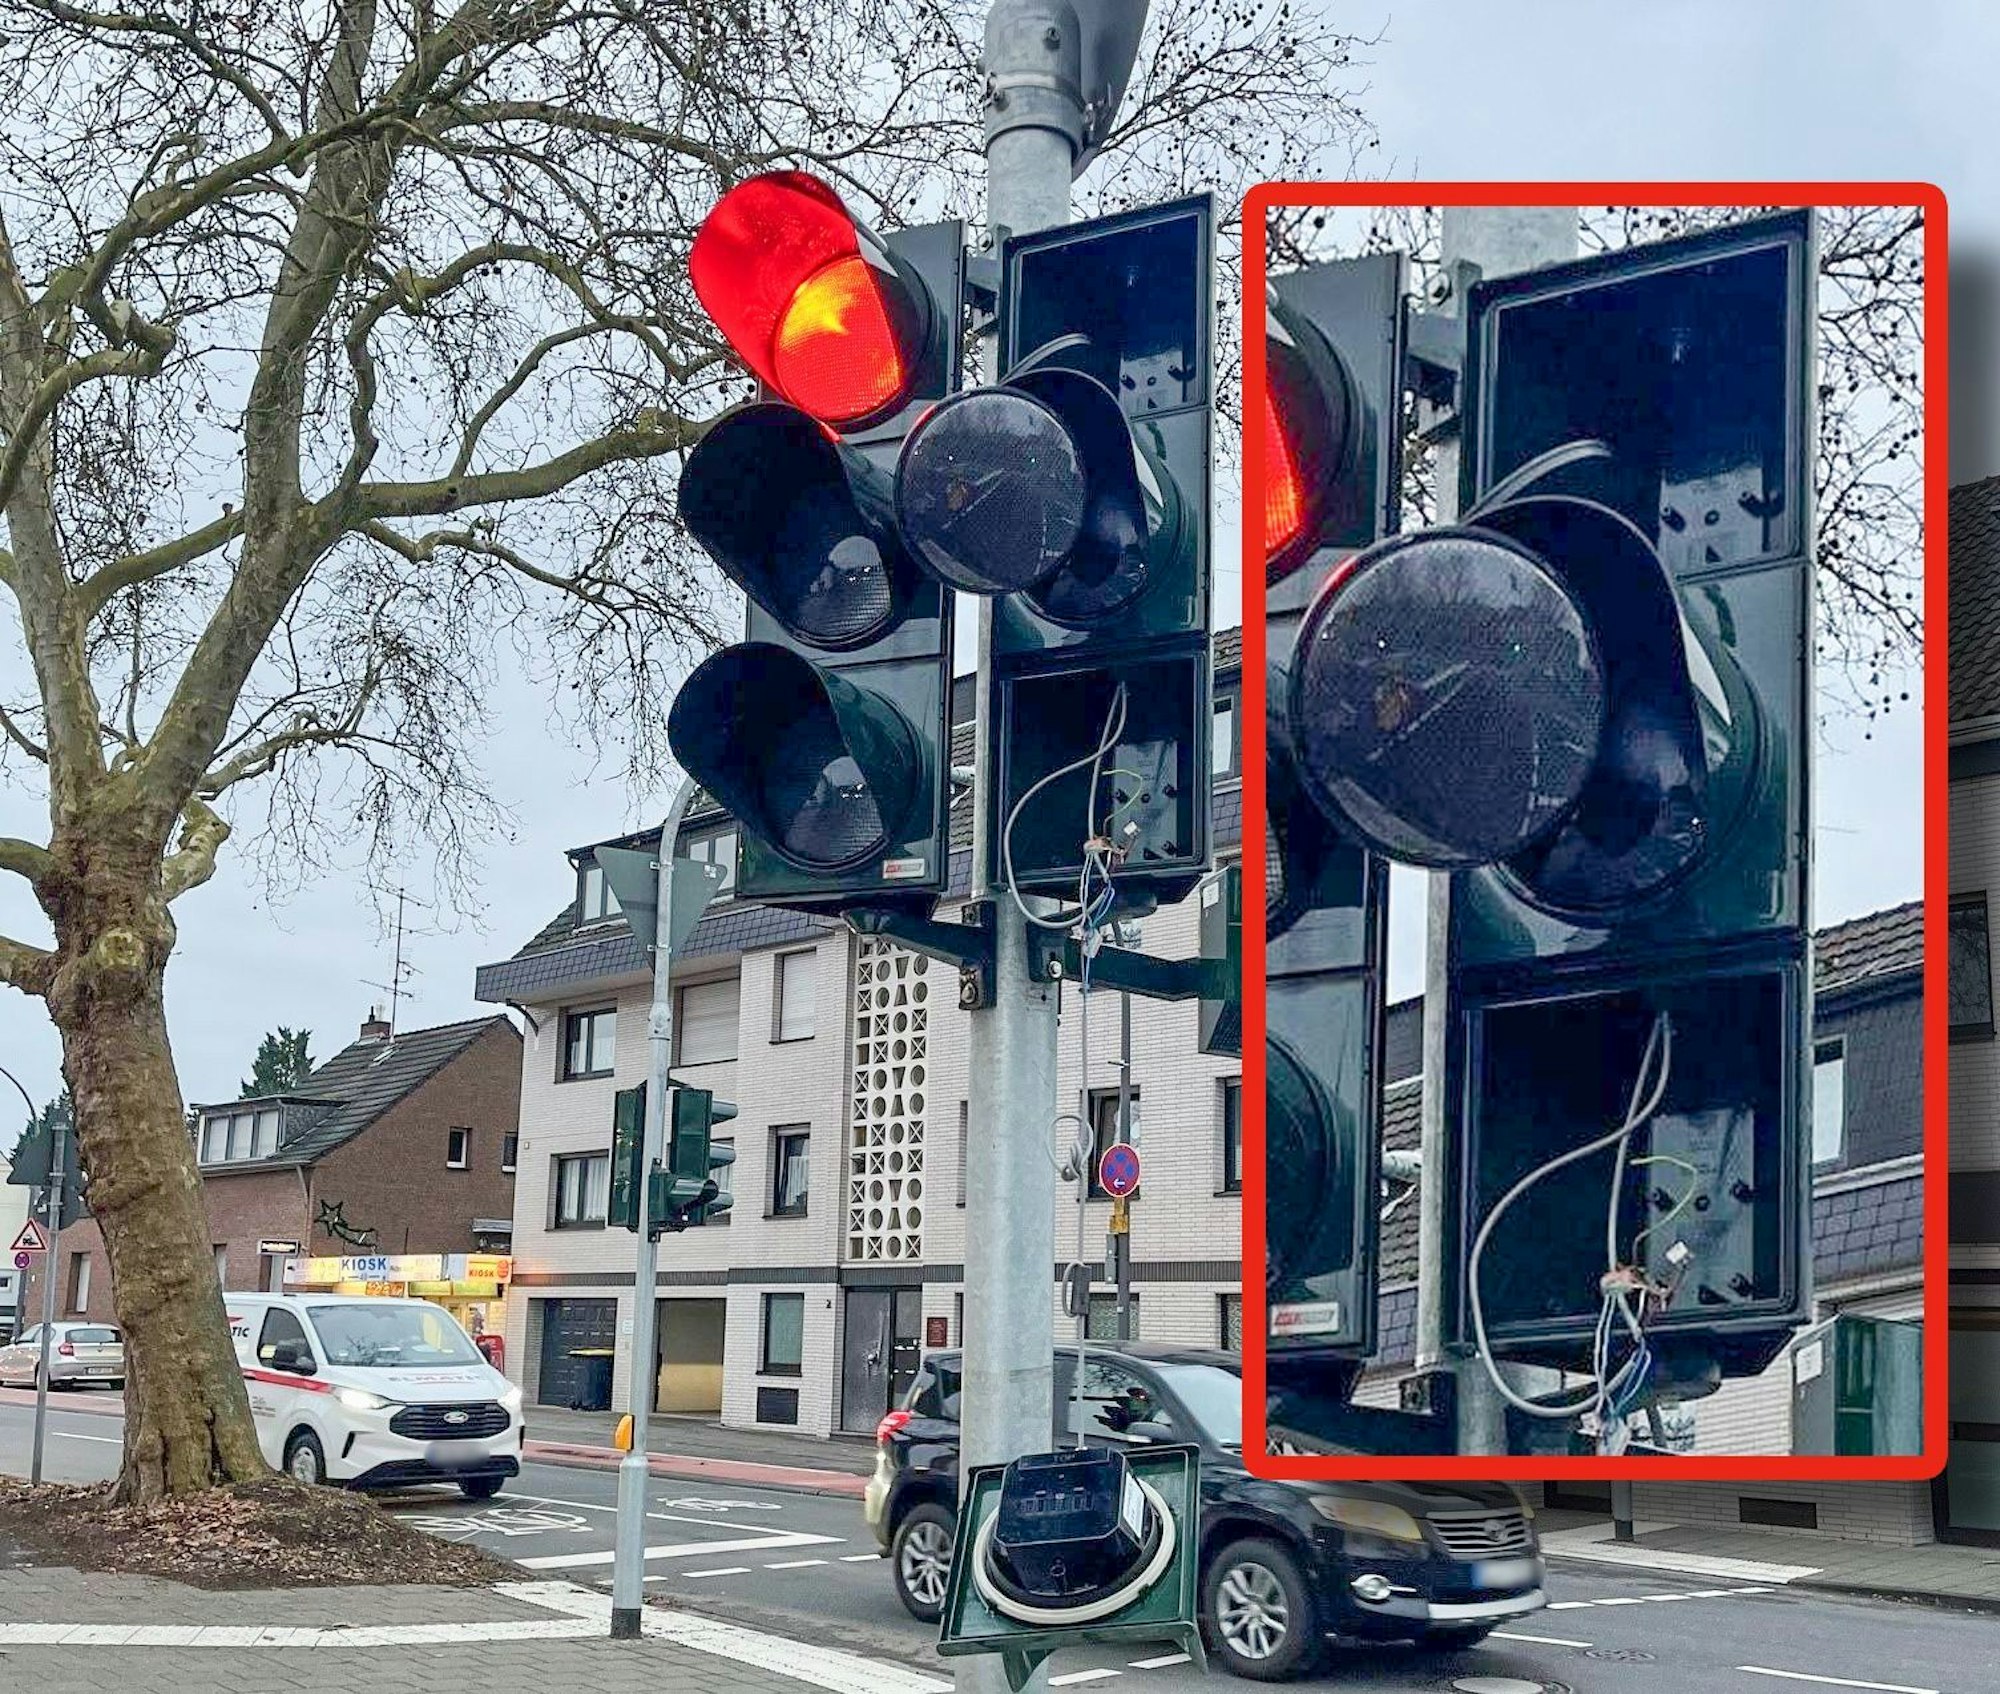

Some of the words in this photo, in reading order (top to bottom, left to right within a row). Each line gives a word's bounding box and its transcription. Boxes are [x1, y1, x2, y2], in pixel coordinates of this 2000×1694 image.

[341, 1257, 387, 1271] KIOSK
[469, 1269, 494, 1278] KIOSK
[231, 1326, 250, 1338] TIC
